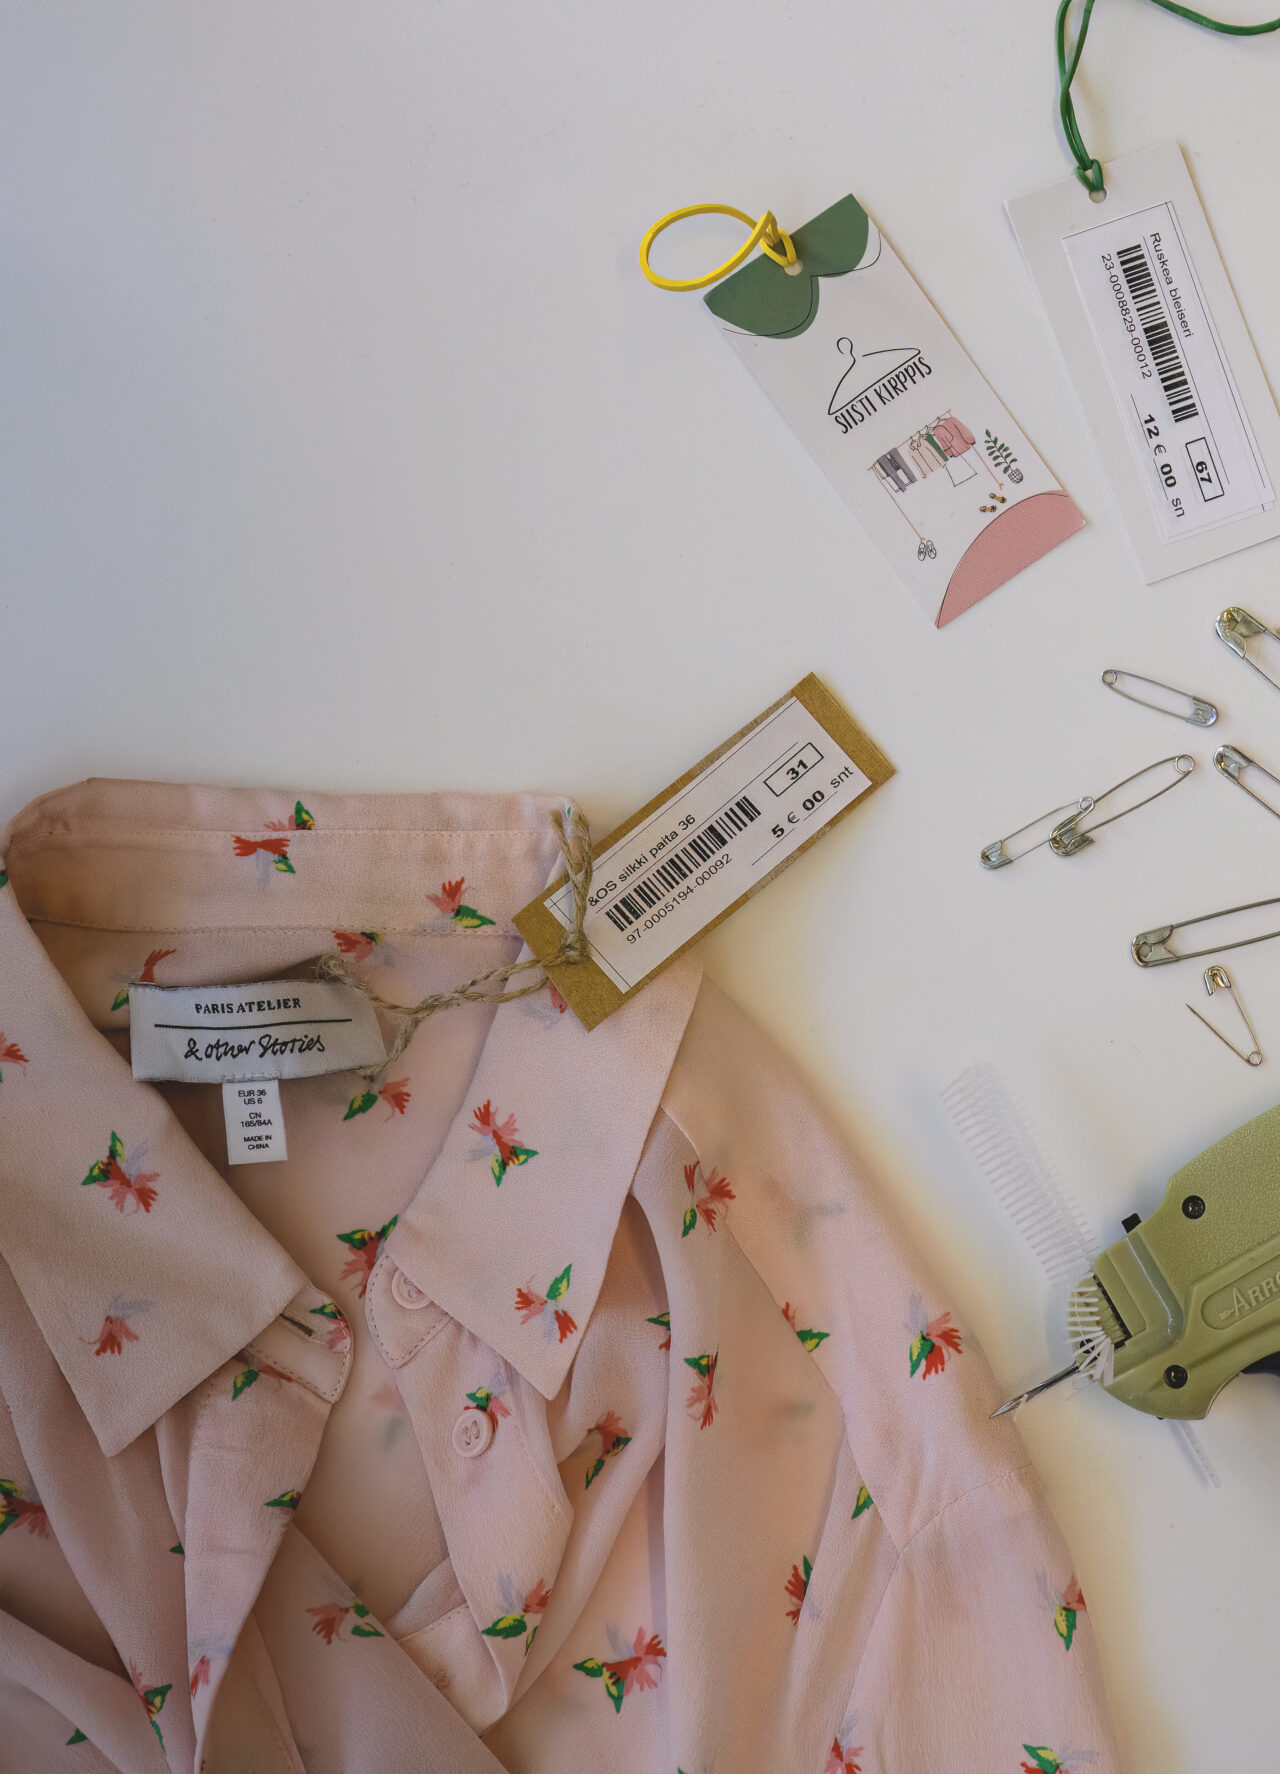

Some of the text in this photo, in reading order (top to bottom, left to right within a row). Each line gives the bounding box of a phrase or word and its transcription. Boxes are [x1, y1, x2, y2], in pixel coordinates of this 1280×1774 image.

[1150, 233, 1194, 337] Ruskea bleiseri
[1101, 254, 1152, 379] 23-0008829-00012
[834, 357, 932, 434] SIISTI KIRPPIS
[1144, 415, 1159, 439] 12
[1154, 444, 1166, 456] €
[1160, 464, 1176, 488] 00
[1195, 461, 1213, 486] 67
[786, 760, 809, 781] 31
[771, 765, 854, 838] 5 € 00 snt
[588, 814, 696, 907] &OS silkki paita 36
[626, 853, 733, 944] 97-0005194-00092
[195, 998, 301, 1014] PARIS ATELIER
[184, 1034, 325, 1061] & other Stories
[257, 1089, 266, 1097] 36
[240, 1119, 272, 1127] 165/84A
[244, 1135, 264, 1143] MADE
